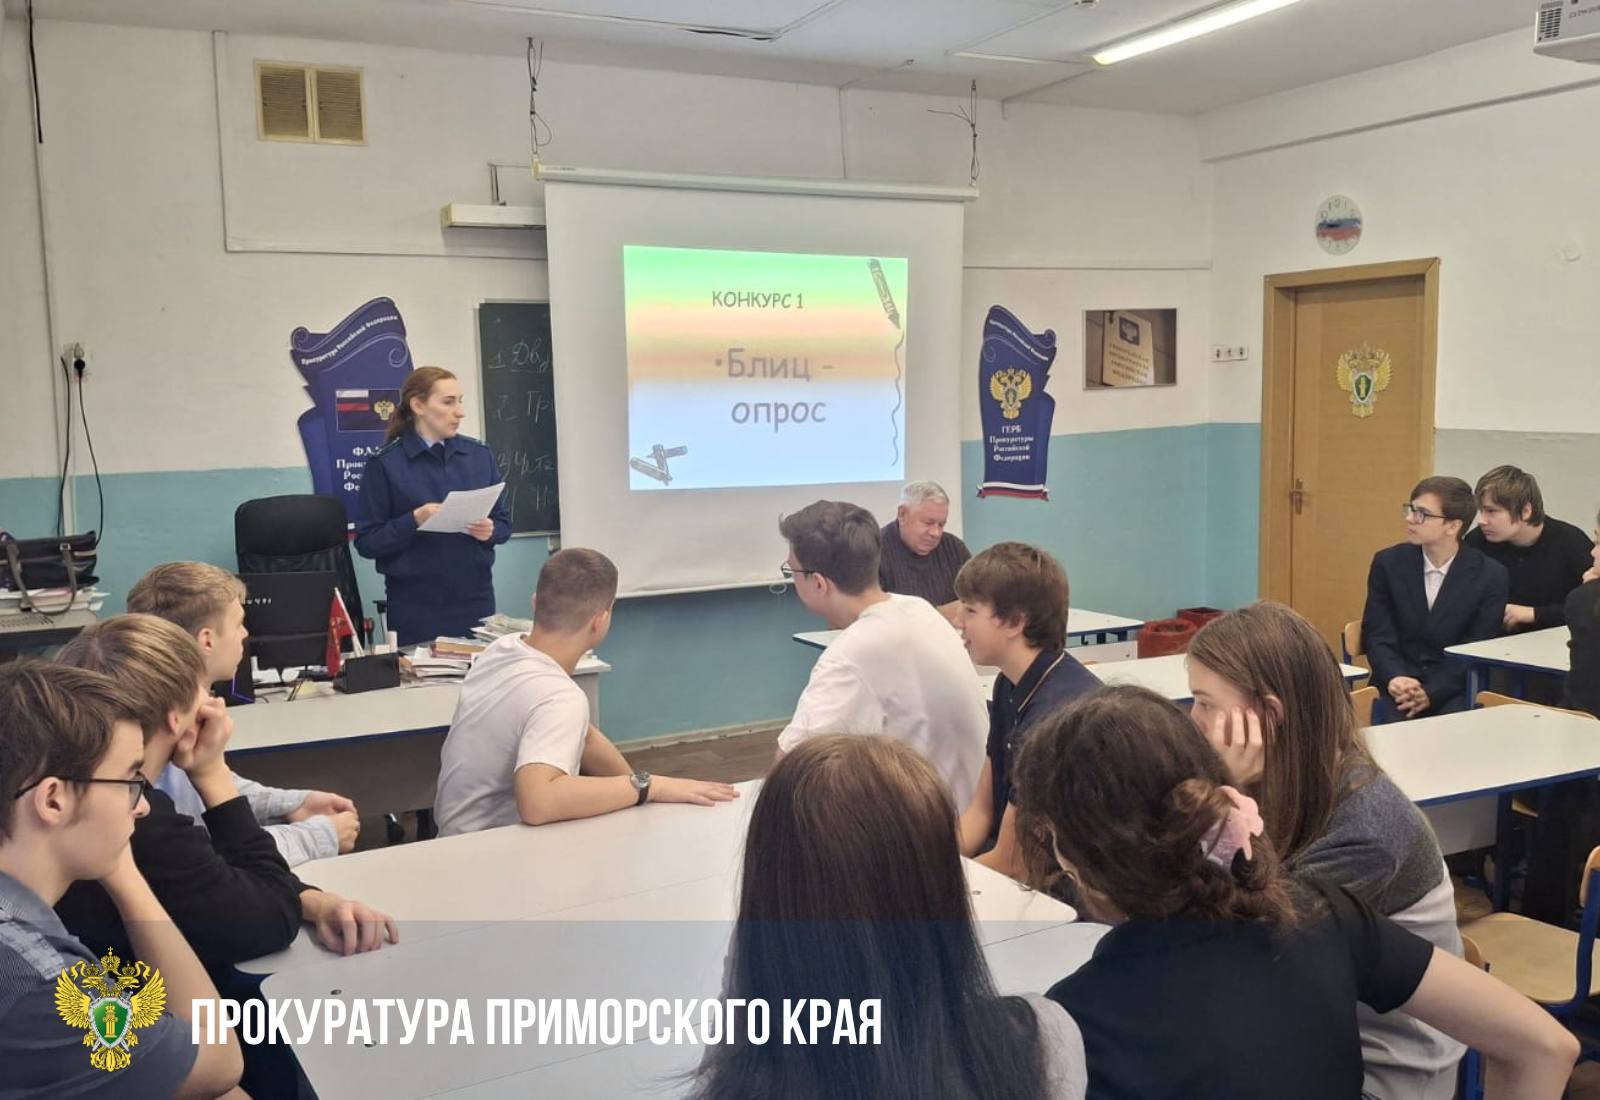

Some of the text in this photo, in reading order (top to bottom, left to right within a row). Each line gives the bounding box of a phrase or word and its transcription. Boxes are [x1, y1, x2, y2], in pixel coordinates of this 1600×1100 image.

[712, 290, 804, 309] КОНКУРС 1
[726, 347, 812, 382] Блиц
[731, 400, 827, 433] опрос
